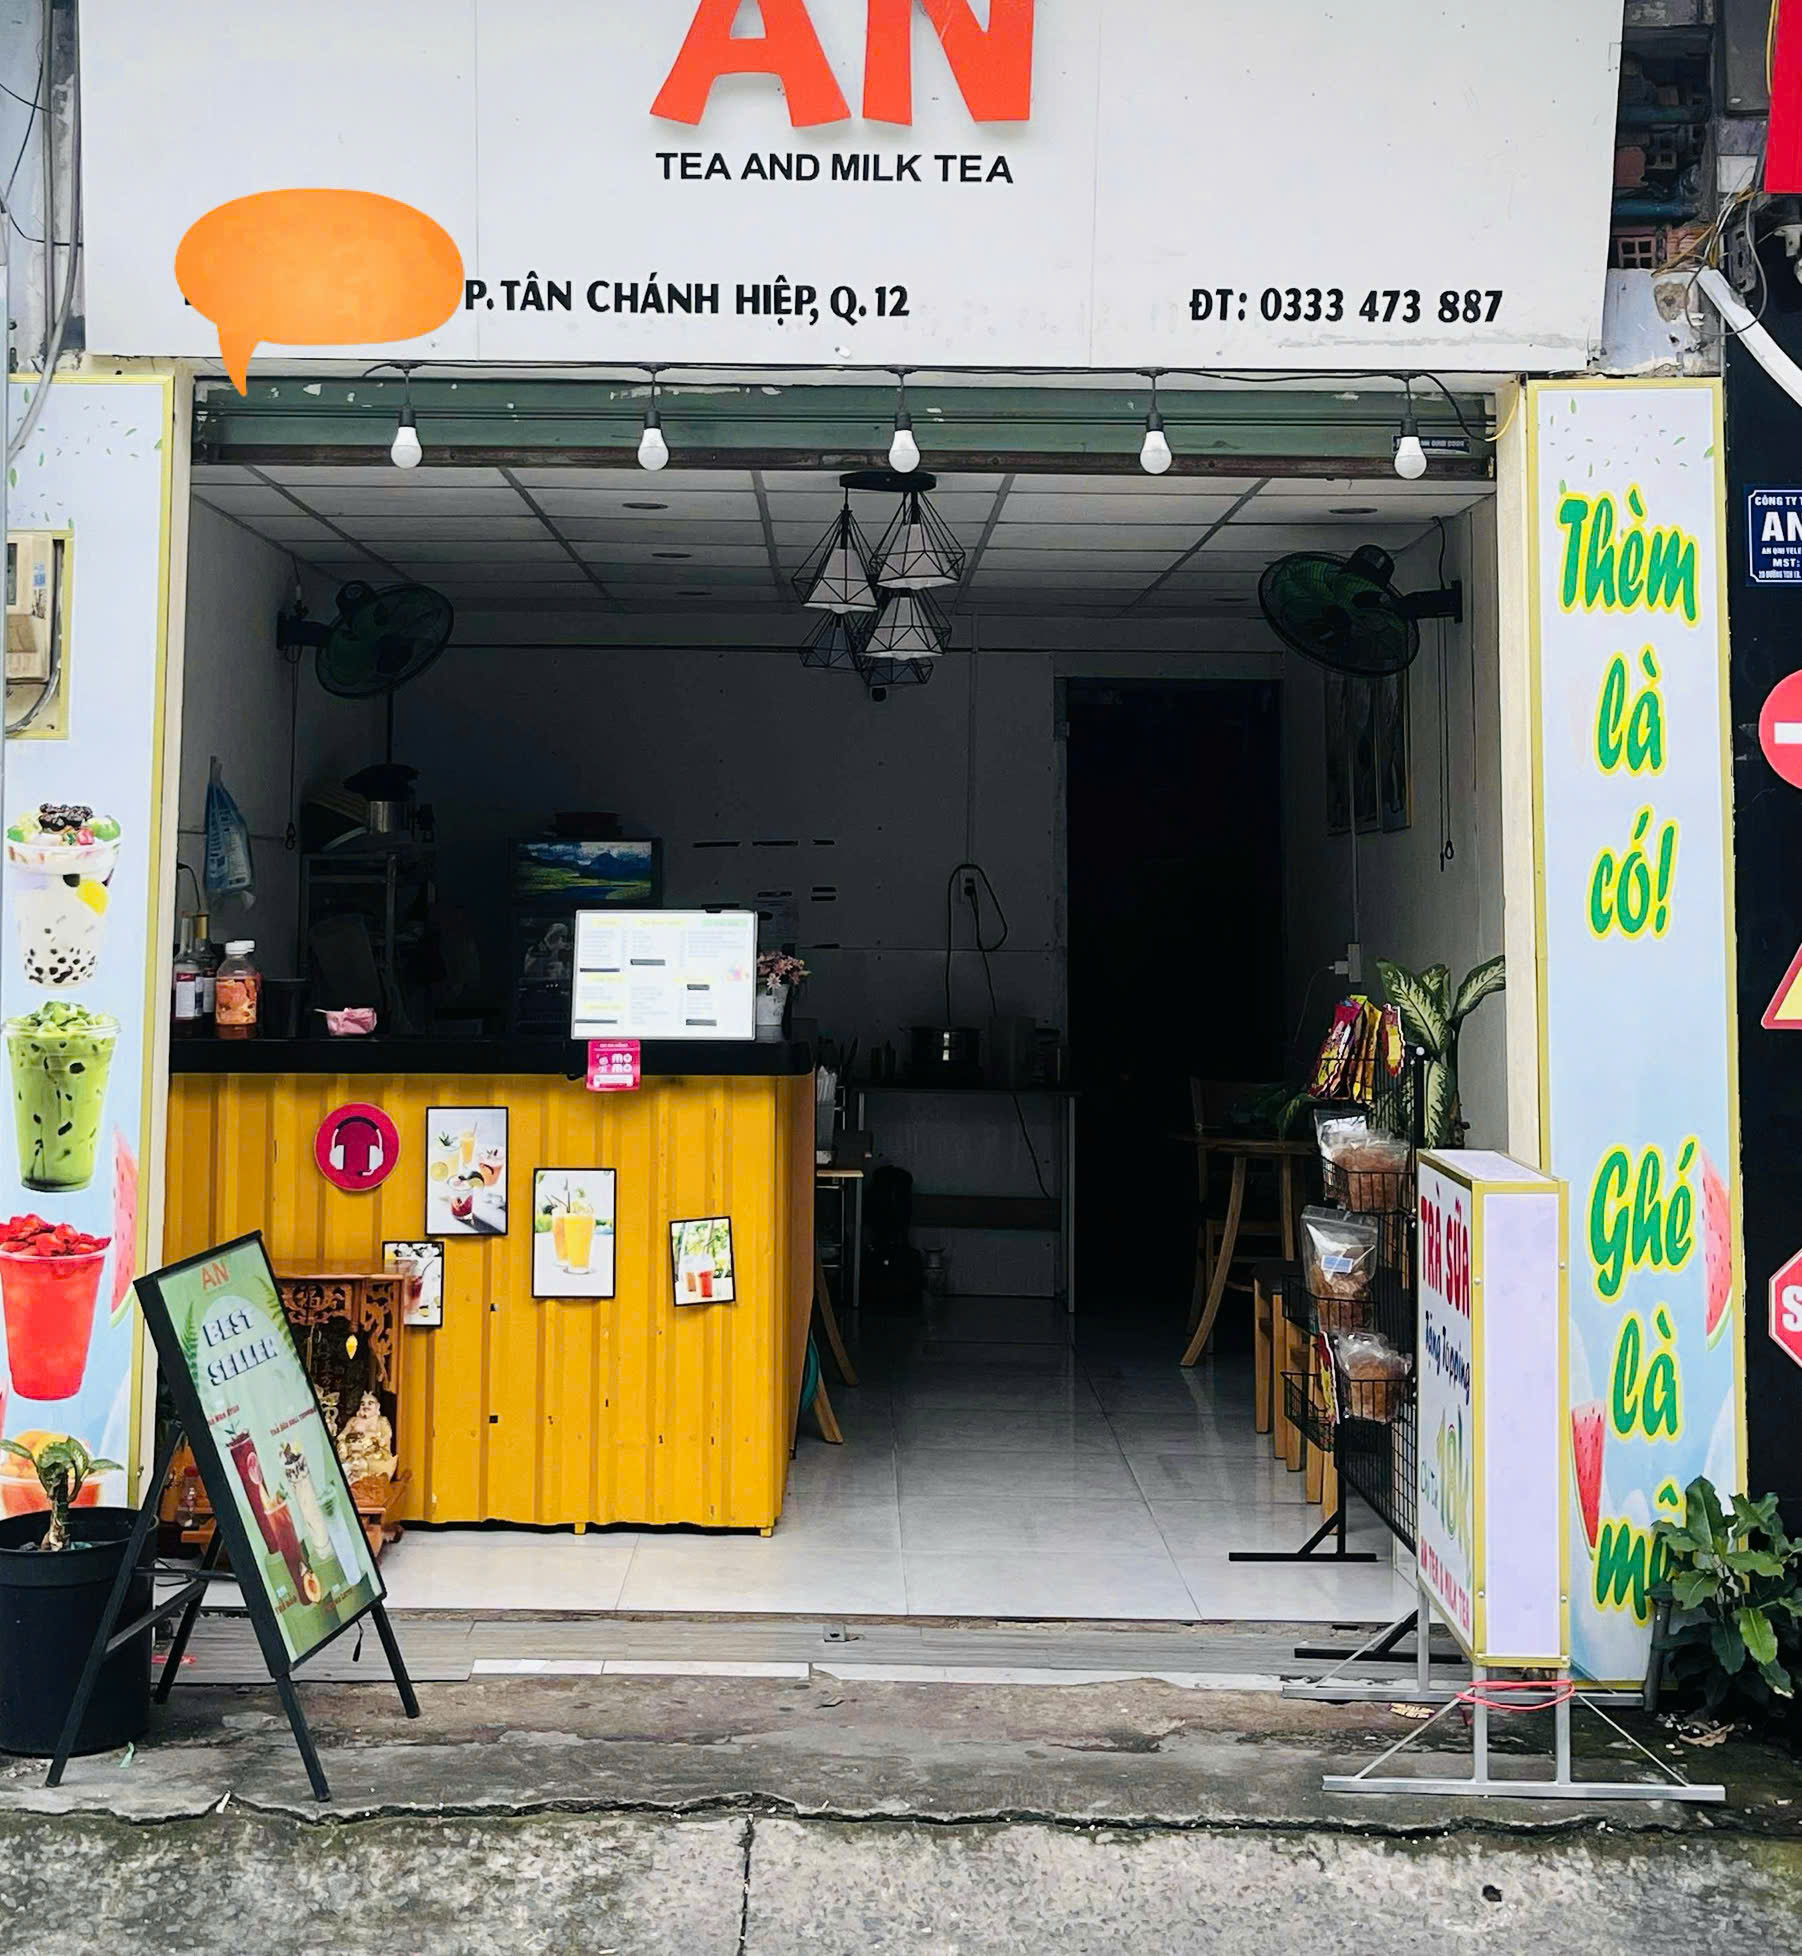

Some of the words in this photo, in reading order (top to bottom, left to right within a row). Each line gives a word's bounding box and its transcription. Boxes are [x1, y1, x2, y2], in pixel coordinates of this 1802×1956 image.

[649, 0, 1034, 127] AN
[655, 152, 732, 181] TEA
[740, 152, 821, 182] AND
[830, 153, 923, 183] MILK
[933, 154, 1014, 184] TEA
[586, 271, 720, 314] CHÁNH
[735, 274, 819, 326] HIỆP,
[1188, 288, 1248, 322] ĐT:
[1260, 287, 1344, 322] 0333
[1358, 289, 1421, 324] 473
[1437, 289, 1503, 324] 887
[1754, 495, 1784, 506] CÔNG
[1785, 496, 1798, 506] TY
[1761, 511, 1802, 542] AN
[1557, 485, 1699, 624] Thèm
[1772, 558, 1801, 568] MST:
[1596, 646, 1665, 774] là
[1588, 807, 1677, 937] có!
[1588, 1139, 1697, 1299] Ghé
[201, 1260, 230, 1291] AN
[1420, 1181, 1442, 1296] TRÀ
[1445, 1195, 1470, 1321] SỮA
[202, 1307, 255, 1348] BEST
[207, 1335, 278, 1387] SELLER
[1441, 1325, 1470, 1406] Topping
[1610, 1307, 1680, 1438] là
